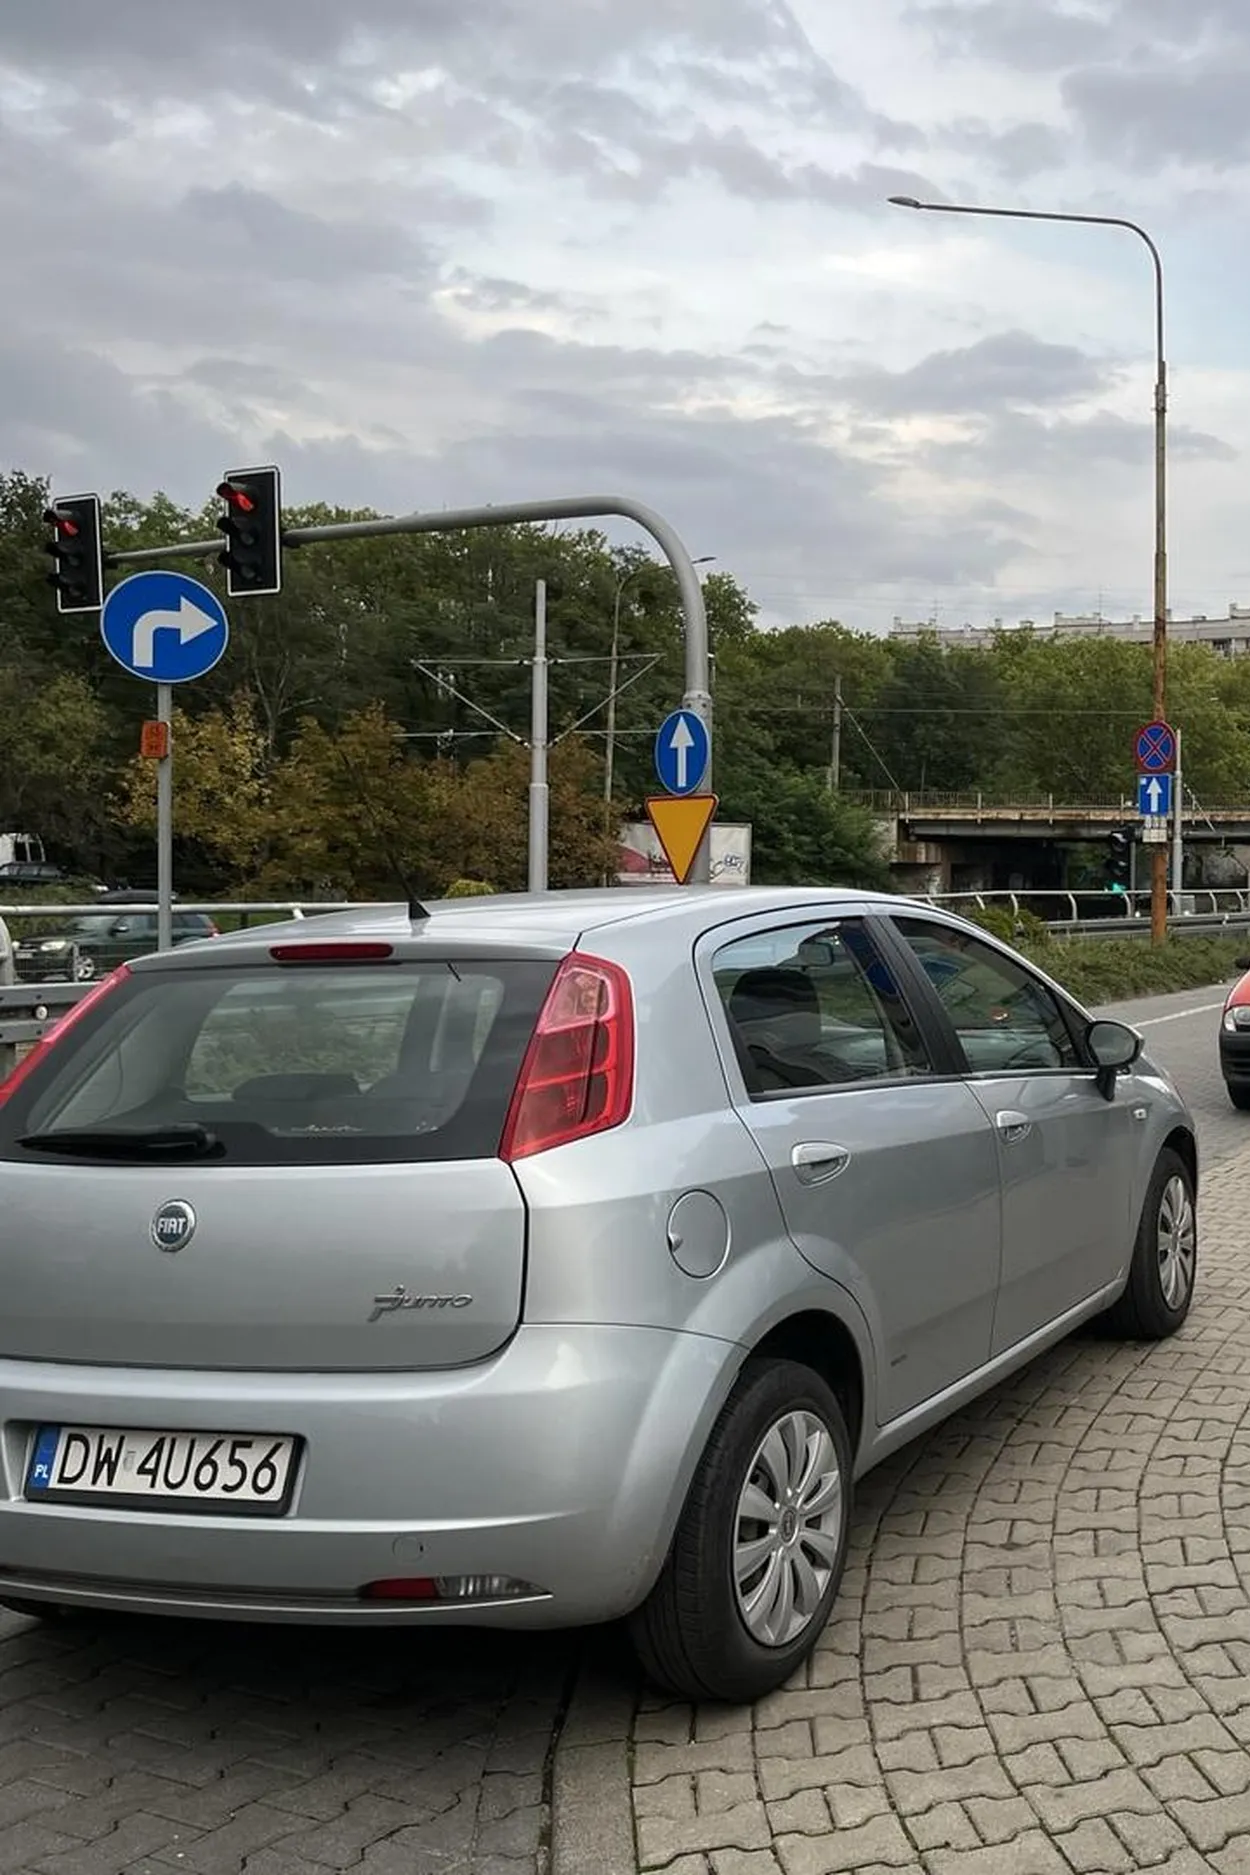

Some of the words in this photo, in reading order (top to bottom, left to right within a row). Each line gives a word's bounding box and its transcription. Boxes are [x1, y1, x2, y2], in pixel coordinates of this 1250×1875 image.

[157, 1217, 187, 1235] FIAT
[34, 1464, 49, 1479] PL
[57, 1433, 125, 1486] DW
[137, 1436, 286, 1495] 4U656
